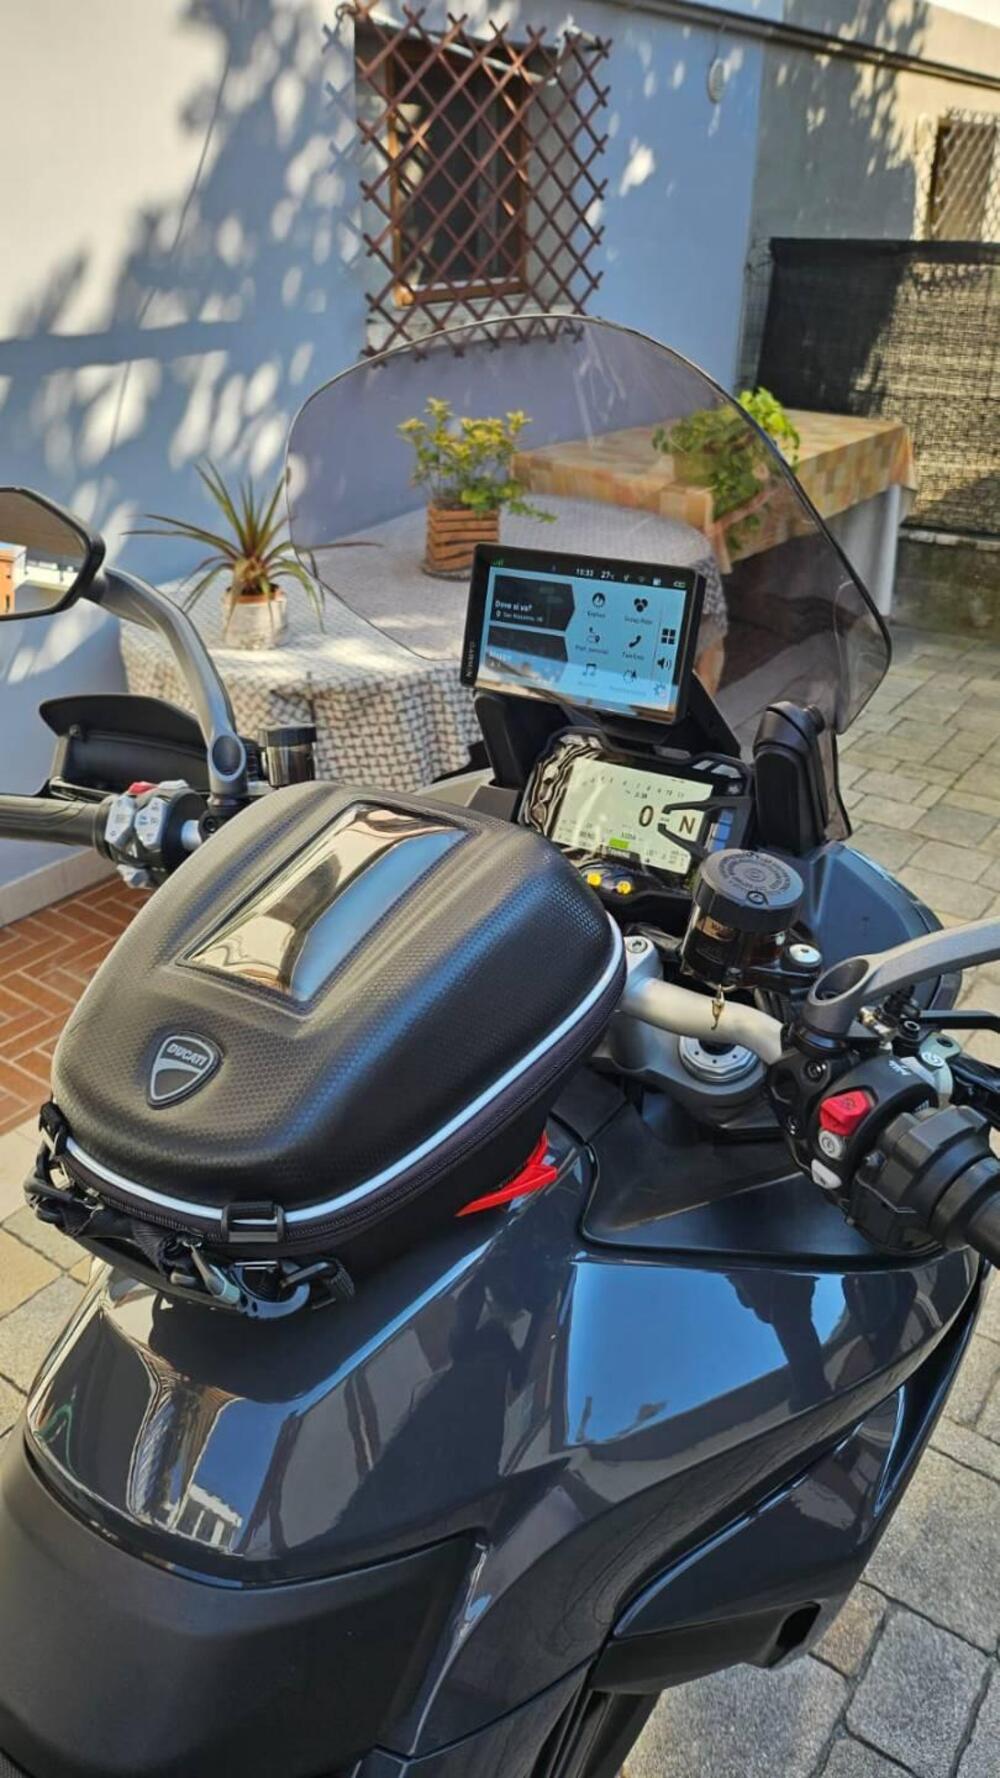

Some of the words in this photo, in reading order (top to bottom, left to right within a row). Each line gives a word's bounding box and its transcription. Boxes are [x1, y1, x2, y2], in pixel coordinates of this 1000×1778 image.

[638, 804, 654, 828] 0
[679, 815, 696, 835] N
[166, 1043, 208, 1066] DUCATI
